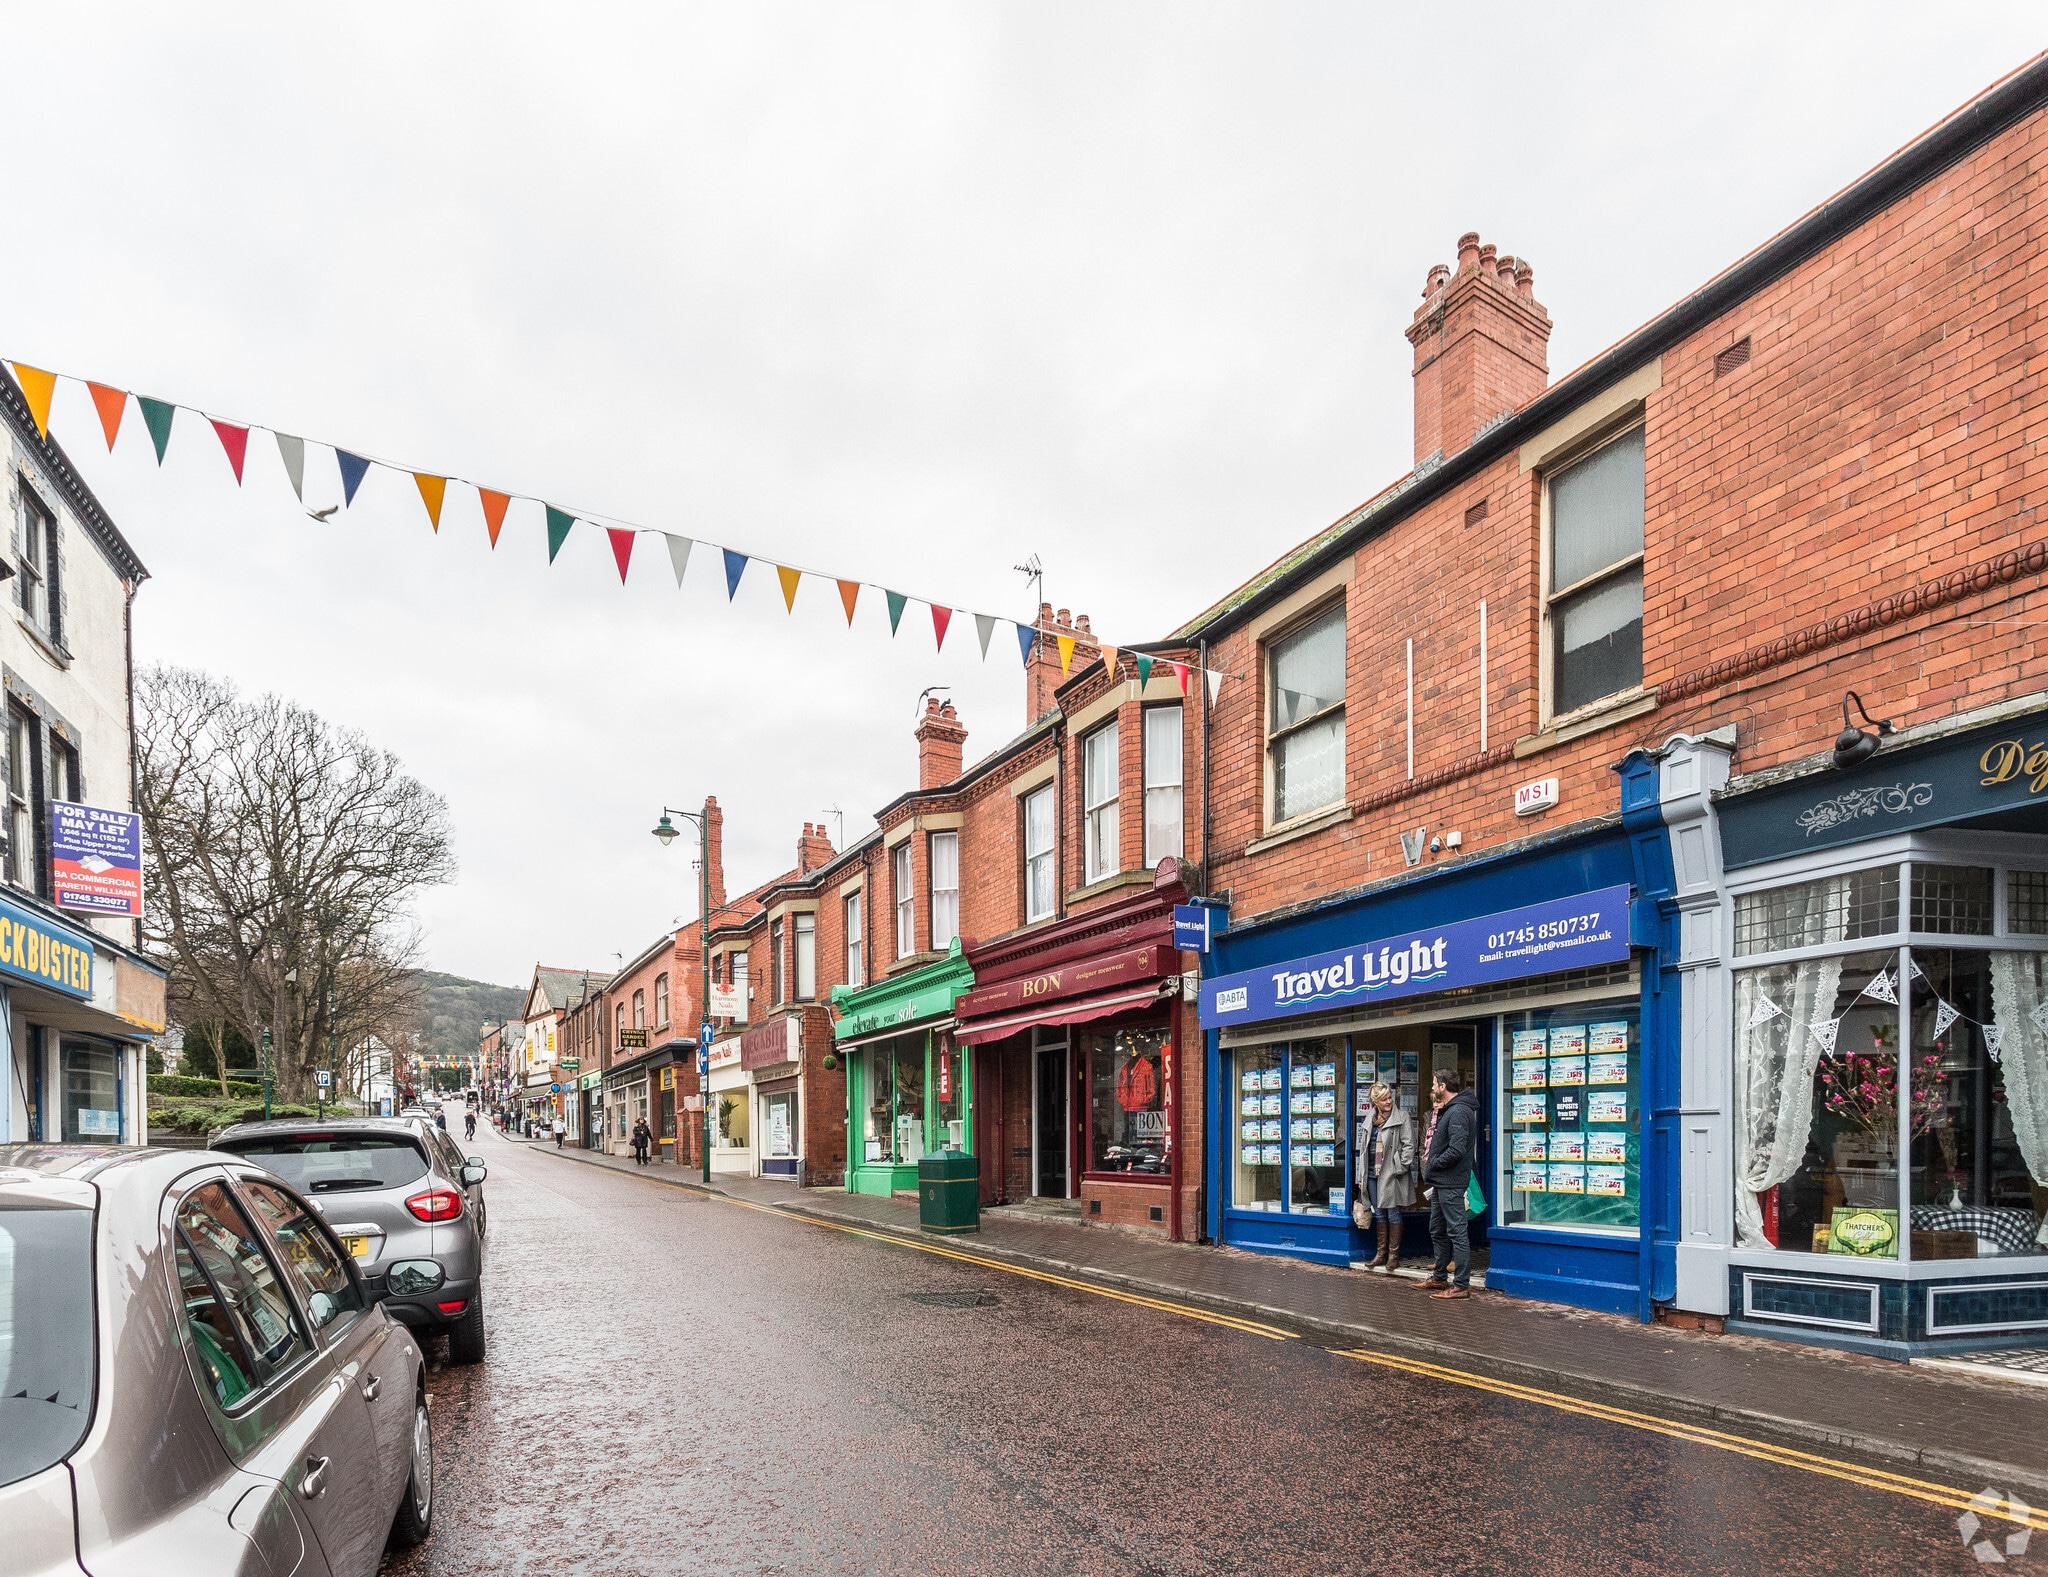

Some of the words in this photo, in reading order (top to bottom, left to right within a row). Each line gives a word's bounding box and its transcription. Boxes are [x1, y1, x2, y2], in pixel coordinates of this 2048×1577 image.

[1519, 782, 1549, 804] MSI
[54, 804, 86, 819] FOR
[90, 810, 132, 827] SALE/
[58, 827, 80, 836] 1,646
[92, 831, 98, 839] ft
[100, 834, 116, 842] (153
[61, 817, 95, 831] MAY
[99, 824, 127, 836] LET
[53, 842, 97, 854] Development
[98, 849, 136, 860] opportunity
[63, 836, 80, 844] Plus
[82, 838, 105, 849] Upper
[106, 843, 125, 851] Parts
[54, 870, 68, 879] BA
[70, 872, 138, 889] COMMERCIAL
[54, 880, 92, 891] GARETH
[94, 885, 138, 897] WILLIAMS
[63, 892, 91, 902] 01745
[93, 896, 127, 906] 330077
[1175, 920, 1191, 929] Travel
[1191, 922, 1205, 931] Light
[1488, 926, 1535, 949] 01745
[1538, 912, 1600, 939] 850737
[0, 916, 90, 992] CKBUSTER
[1479, 951, 1503, 963] Email:
[1505, 930, 1612, 958] travellight@vsmail.co.uk
[1075, 969, 1097, 980] designer
[1097, 962, 1125, 975] menswear
[1271, 954, 1354, 1000] Travel
[1363, 936, 1448, 984] Light
[1022, 973, 1063, 998] BON
[1225, 991, 1246, 1004] ABTA
[852, 1014, 879, 1034] elevate
[898, 999, 917, 1022] sole
[1138, 1112, 1163, 1130] BON
[1845, 1222, 1885, 1232] THATCHERS
